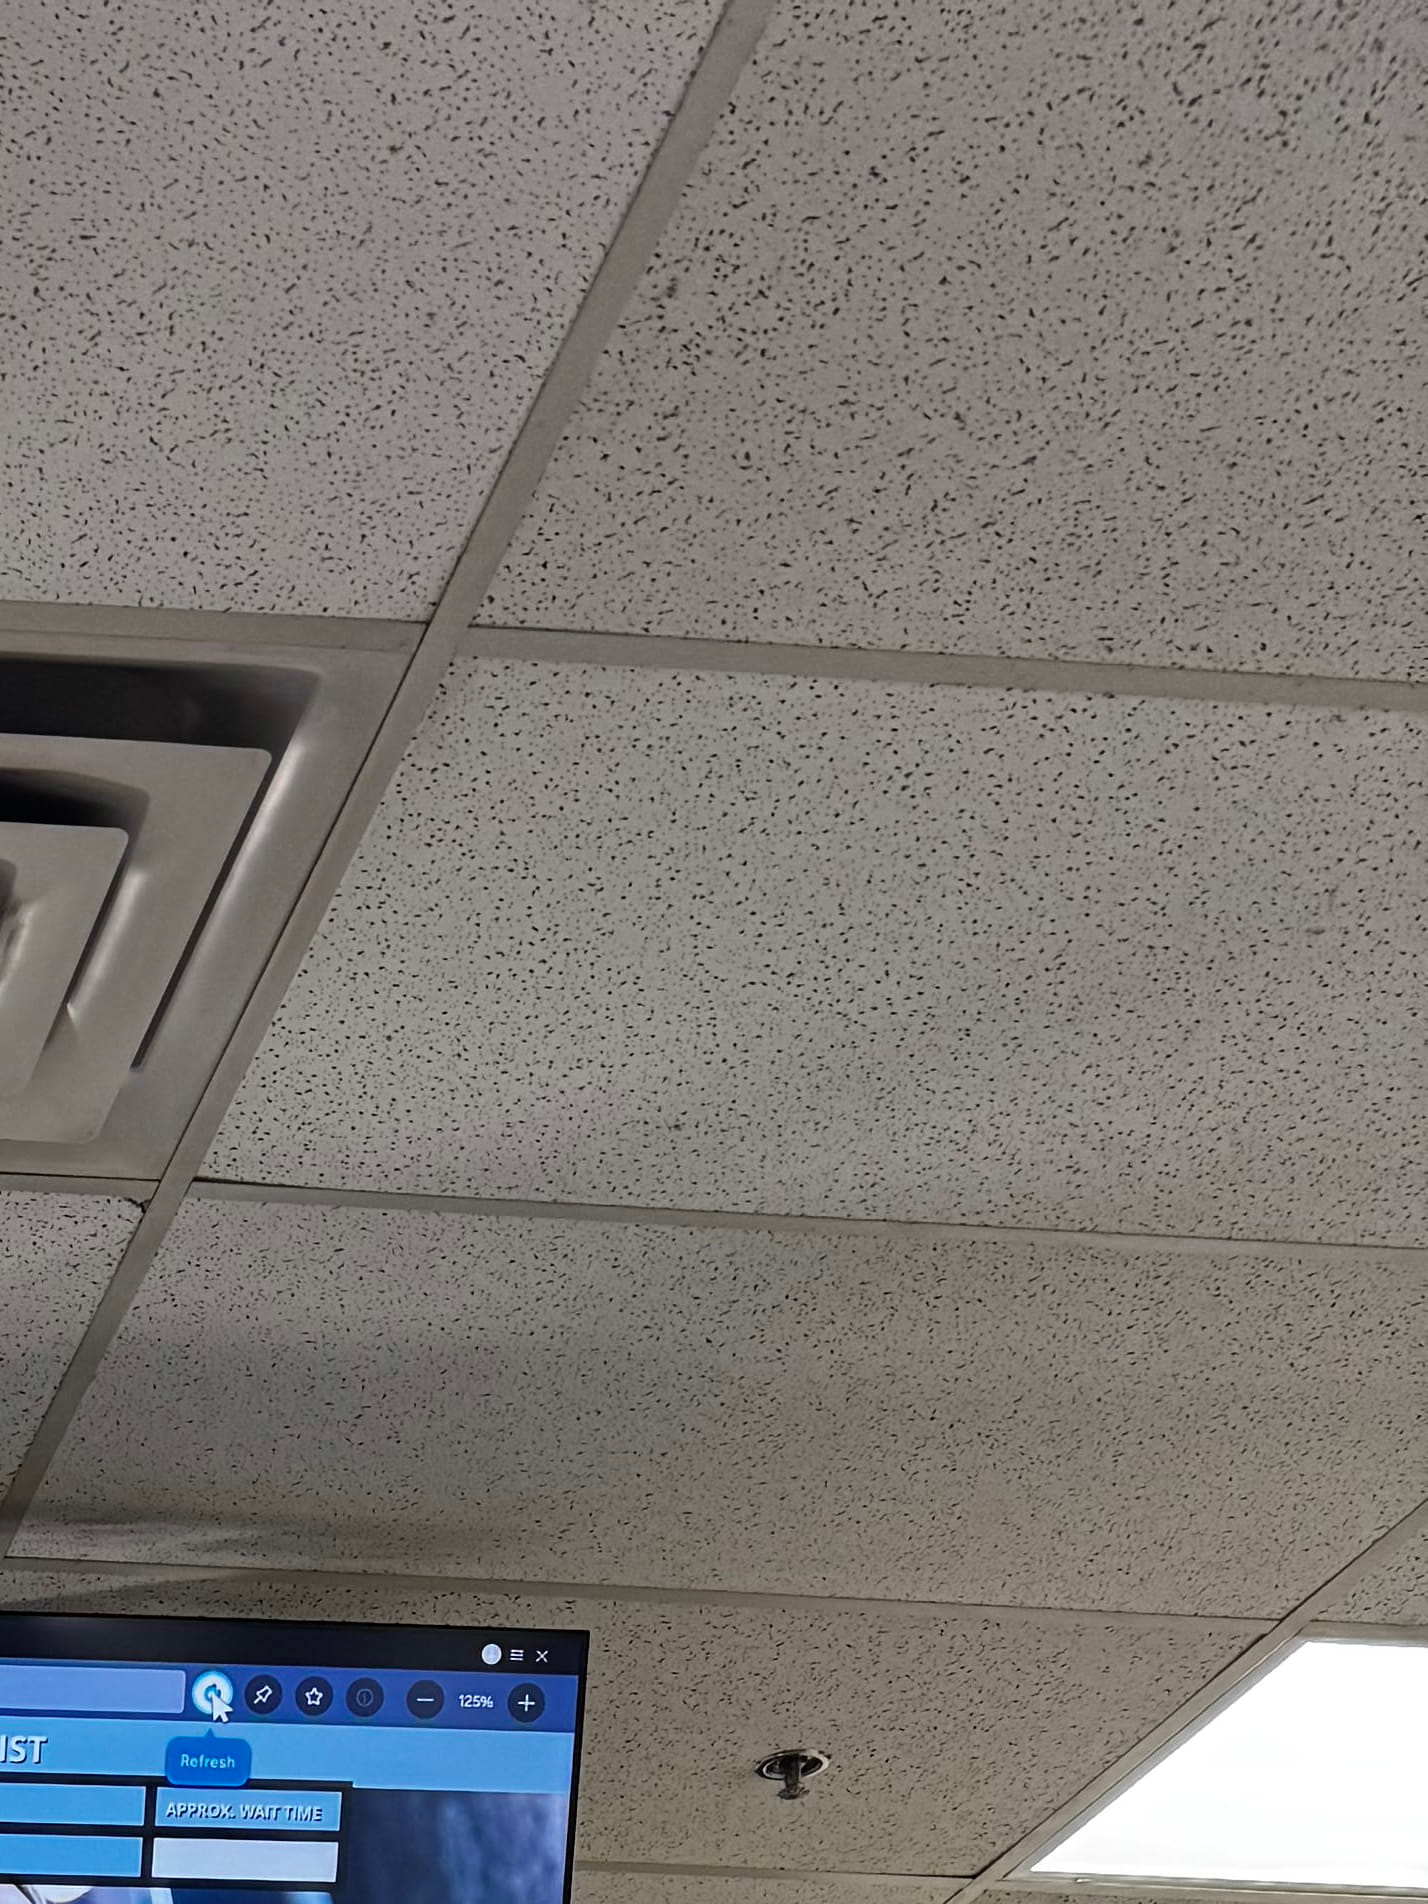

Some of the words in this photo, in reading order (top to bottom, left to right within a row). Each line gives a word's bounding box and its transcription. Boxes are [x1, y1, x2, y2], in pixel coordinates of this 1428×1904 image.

[458, 1694, 494, 1709] 125%
[180, 1753, 236, 1769] Refresh
[165, 1802, 236, 1820] APPROX.
[239, 1804, 282, 1821] WAIT
[284, 1806, 322, 1822] TIME
